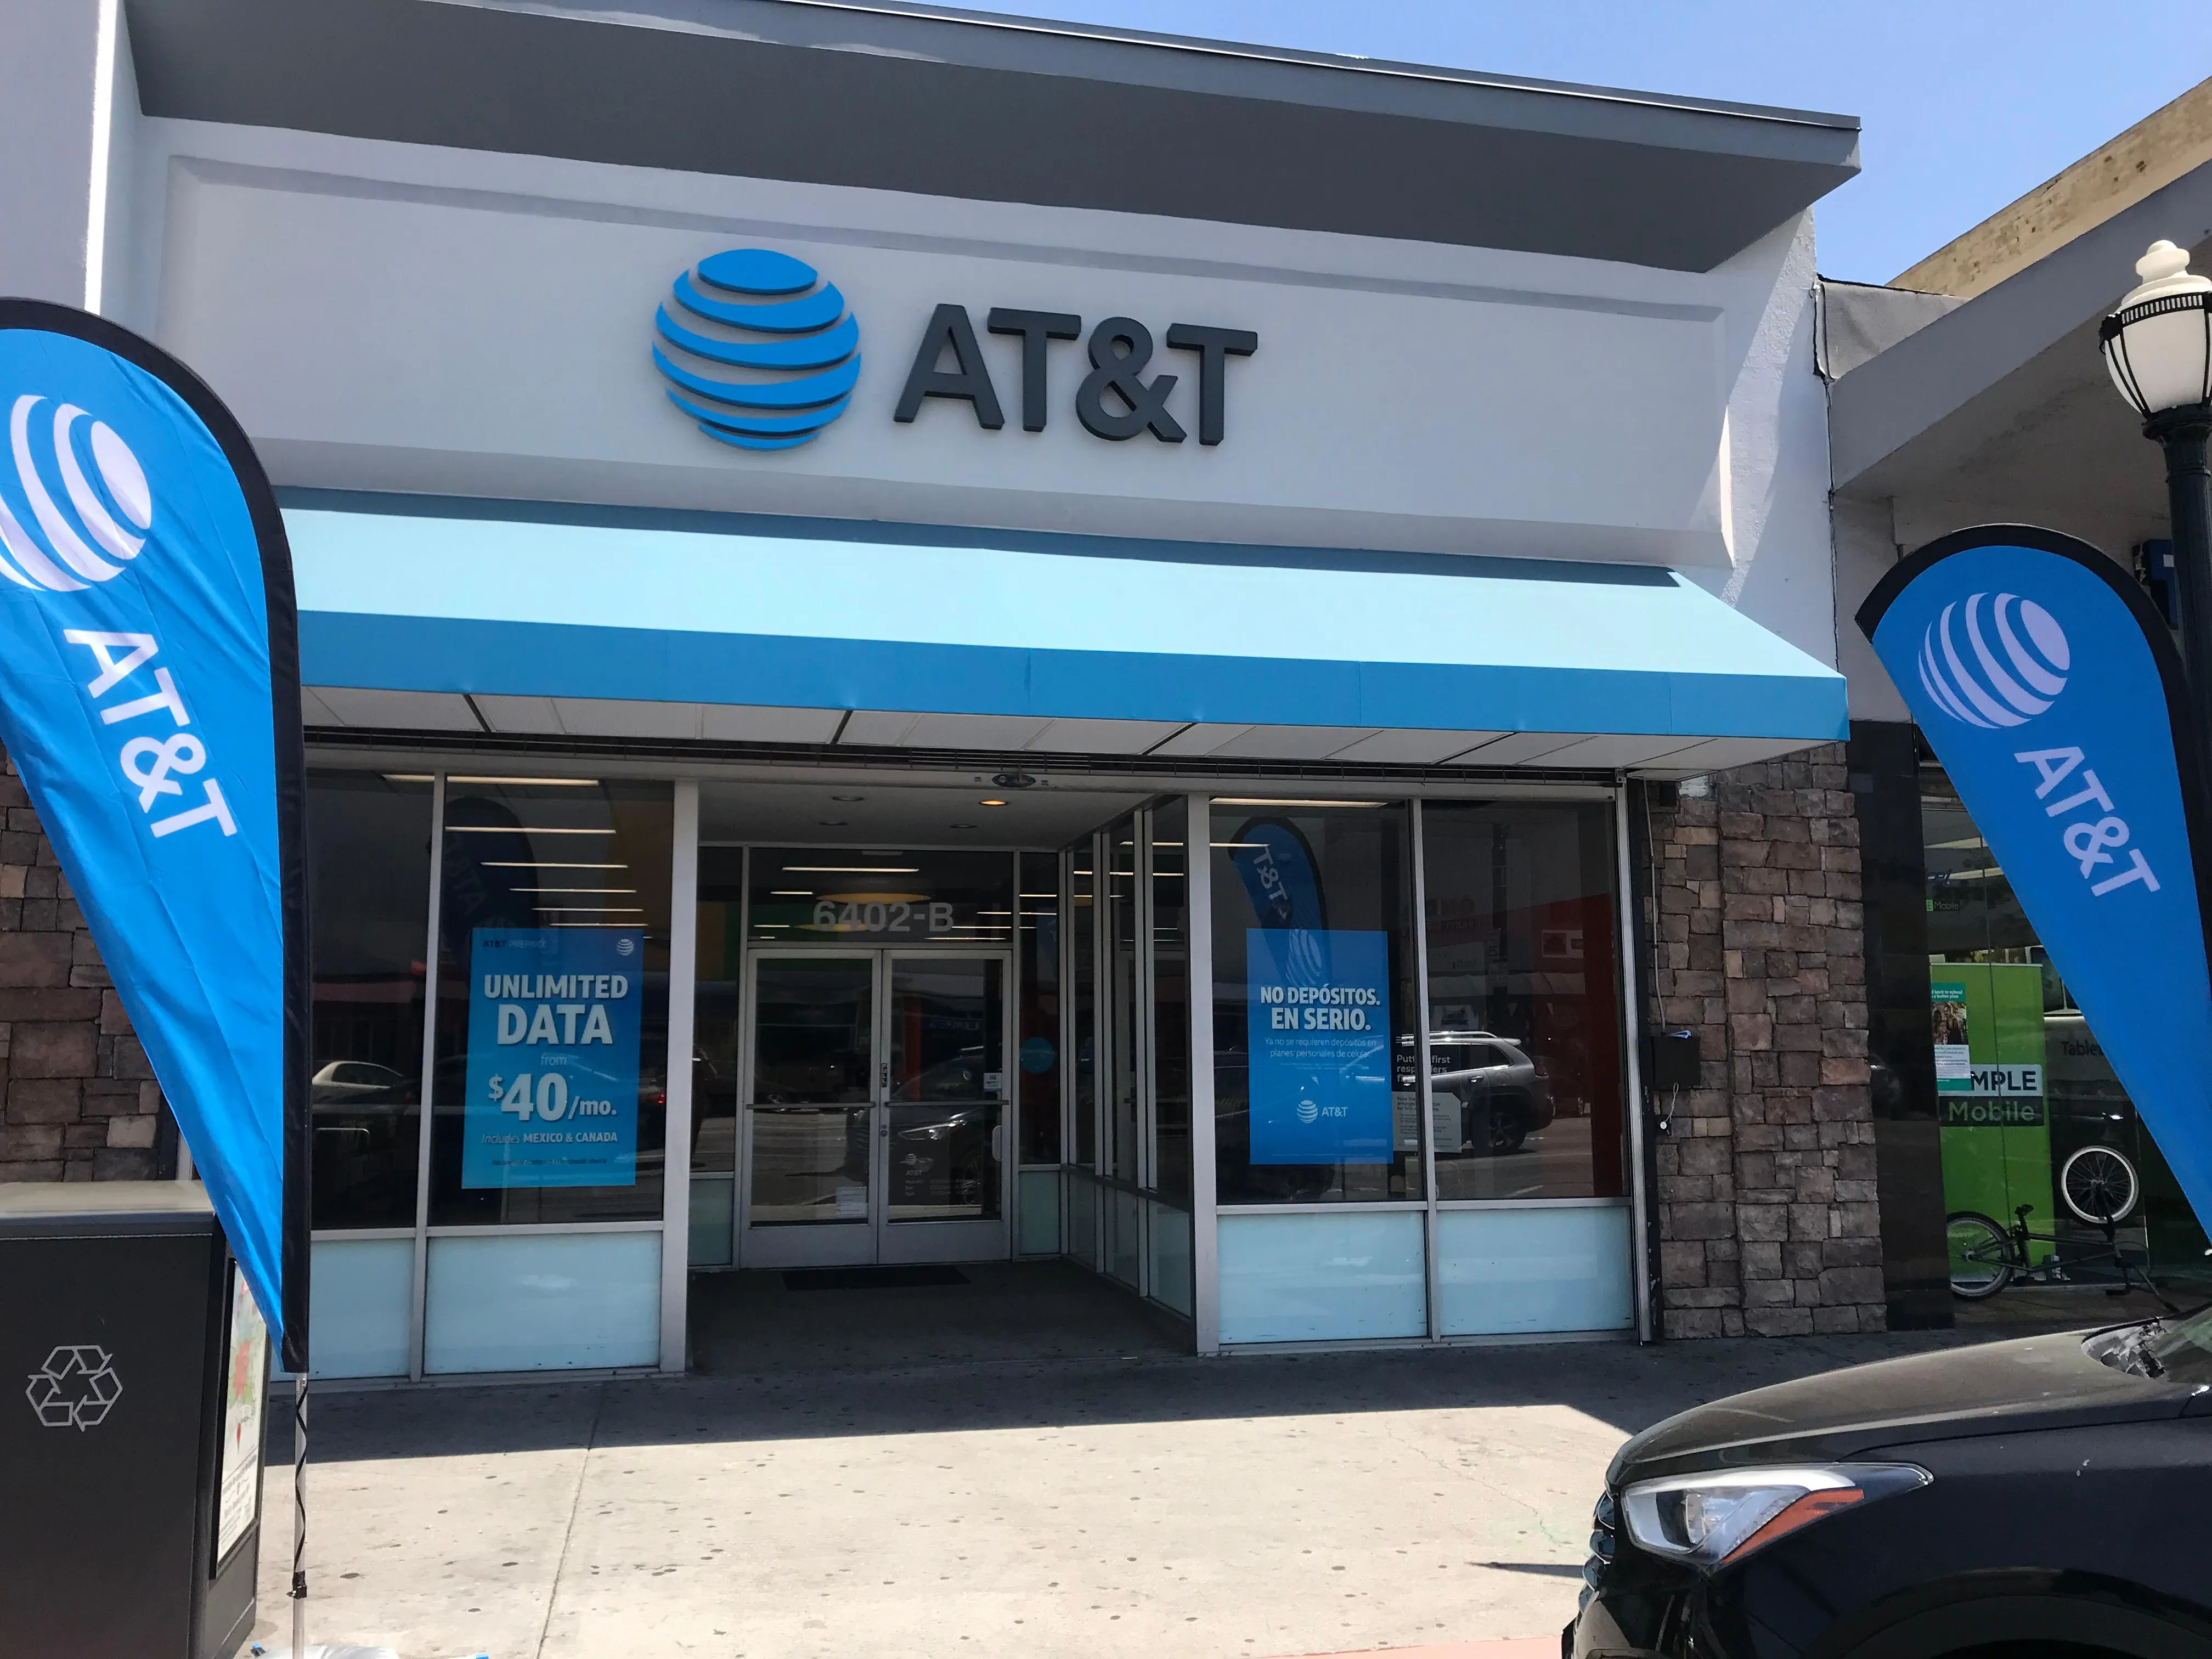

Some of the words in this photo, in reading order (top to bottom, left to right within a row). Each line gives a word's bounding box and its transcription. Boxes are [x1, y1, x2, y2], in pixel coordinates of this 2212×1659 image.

[893, 303, 1259, 446] AT&T
[63, 629, 238, 838] AT&T
[2014, 746, 2161, 897] AT&T
[813, 901, 954, 933] 6402-B
[484, 974, 629, 999] UNLIMITED
[1261, 986, 1284, 1004] NO
[1288, 983, 1381, 1006] DEPÓSITOS.
[498, 1004, 613, 1045] DATA
[1272, 1007, 1299, 1030] EN
[1304, 1008, 1372, 1031] SERIO.
[1265, 1037, 1273, 1046] Ya
[1296, 1037, 1330, 1047] requieren
[1330, 1037, 1367, 1047] depósitos
[2061, 1040, 2103, 1056] Table
[541, 1053, 567, 1066] from
[1296, 1049, 1335, 1059] personales
[1336, 1049, 1345, 1058] de
[1431, 1055, 1451, 1064] first
[1970, 1071, 2037, 1091] MPLE
[1321, 1106, 1348, 1117] AT&T
[1949, 1101, 2035, 1122] Mobile
[481, 1133, 520, 1143] Includes
[523, 1133, 563, 1143] MEXICO
[565, 1133, 573, 1142] &
[575, 1132, 618, 1142] CANADA
